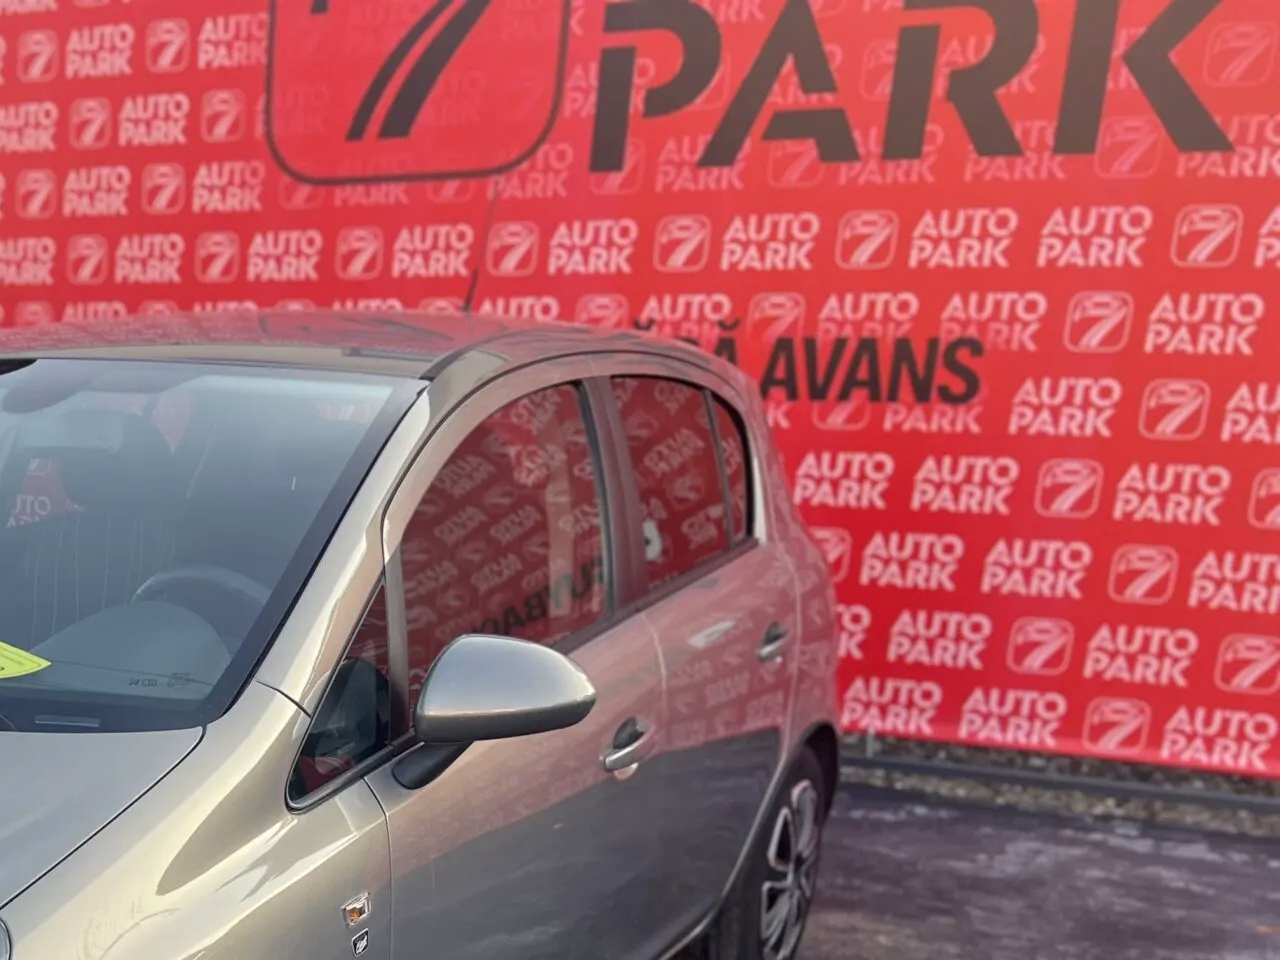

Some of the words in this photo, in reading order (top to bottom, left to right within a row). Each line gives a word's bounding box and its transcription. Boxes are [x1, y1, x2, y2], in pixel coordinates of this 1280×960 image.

[67, 23, 135, 52] AUTO
[199, 12, 269, 43] AUTO
[66, 48, 132, 79] PARK
[197, 39, 268, 71] PARK
[588, 0, 1236, 173] PARK
[120, 92, 191, 121] AUTO
[118, 118, 188, 147] PARK
[65, 165, 132, 193] AUTO
[194, 160, 266, 188] AUTO
[63, 190, 129, 218] PARK
[192, 185, 263, 213] PARK
[395, 223, 474, 251] AUTO
[550, 217, 638, 248] AUTO
[722, 212, 819, 243] AUTO
[911, 207, 1019, 238] AUTO
[1040, 205, 1154, 237] AUTO
[117, 233, 186, 259] AUTO
[250, 229, 323, 254] AUTO
[720, 240, 815, 272] PARK
[907, 236, 1013, 269] PARK
[1036, 235, 1147, 268] PARK
[115, 256, 182, 284] PARK
[247, 253, 319, 282] PARK
[391, 249, 470, 278] PARK
[547, 246, 635, 276] PARK
[478, 296, 560, 325] AUTO
[640, 293, 733, 322] AUTO
[819, 292, 919, 322] AUTO
[941, 292, 1048, 323] AUTO
[1148, 292, 1265, 325] AUTO
[1143, 323, 1258, 356] PARK
[759, 336, 984, 405] AVANS
[1012, 377, 1122, 407] AUTO
[883, 402, 983, 434] PARK
[1007, 404, 1116, 438] PARK
[796, 452, 895, 481] AUTO
[913, 455, 1020, 486] AUTO
[1117, 462, 1231, 496] AUTO
[793, 477, 889, 509] PARK
[909, 482, 1013, 515] PARK
[1112, 491, 1224, 526] PARK
[862, 531, 965, 562] AUTO
[984, 538, 1093, 570] AUTO
[859, 559, 958, 591] PARK
[980, 563, 1086, 599] PARK
[891, 608, 992, 641] AUTO
[1086, 623, 1199, 658] AUTO
[886, 634, 987, 670] PARK
[1082, 650, 1191, 688] PARK
[844, 676, 943, 709] AUTO
[962, 687, 1067, 720] AUTO
[839, 700, 937, 736] PARK
[958, 710, 1061, 747] PARK
[1163, 705, 1279, 743] AUTO
[1159, 731, 1271, 771] PARK
